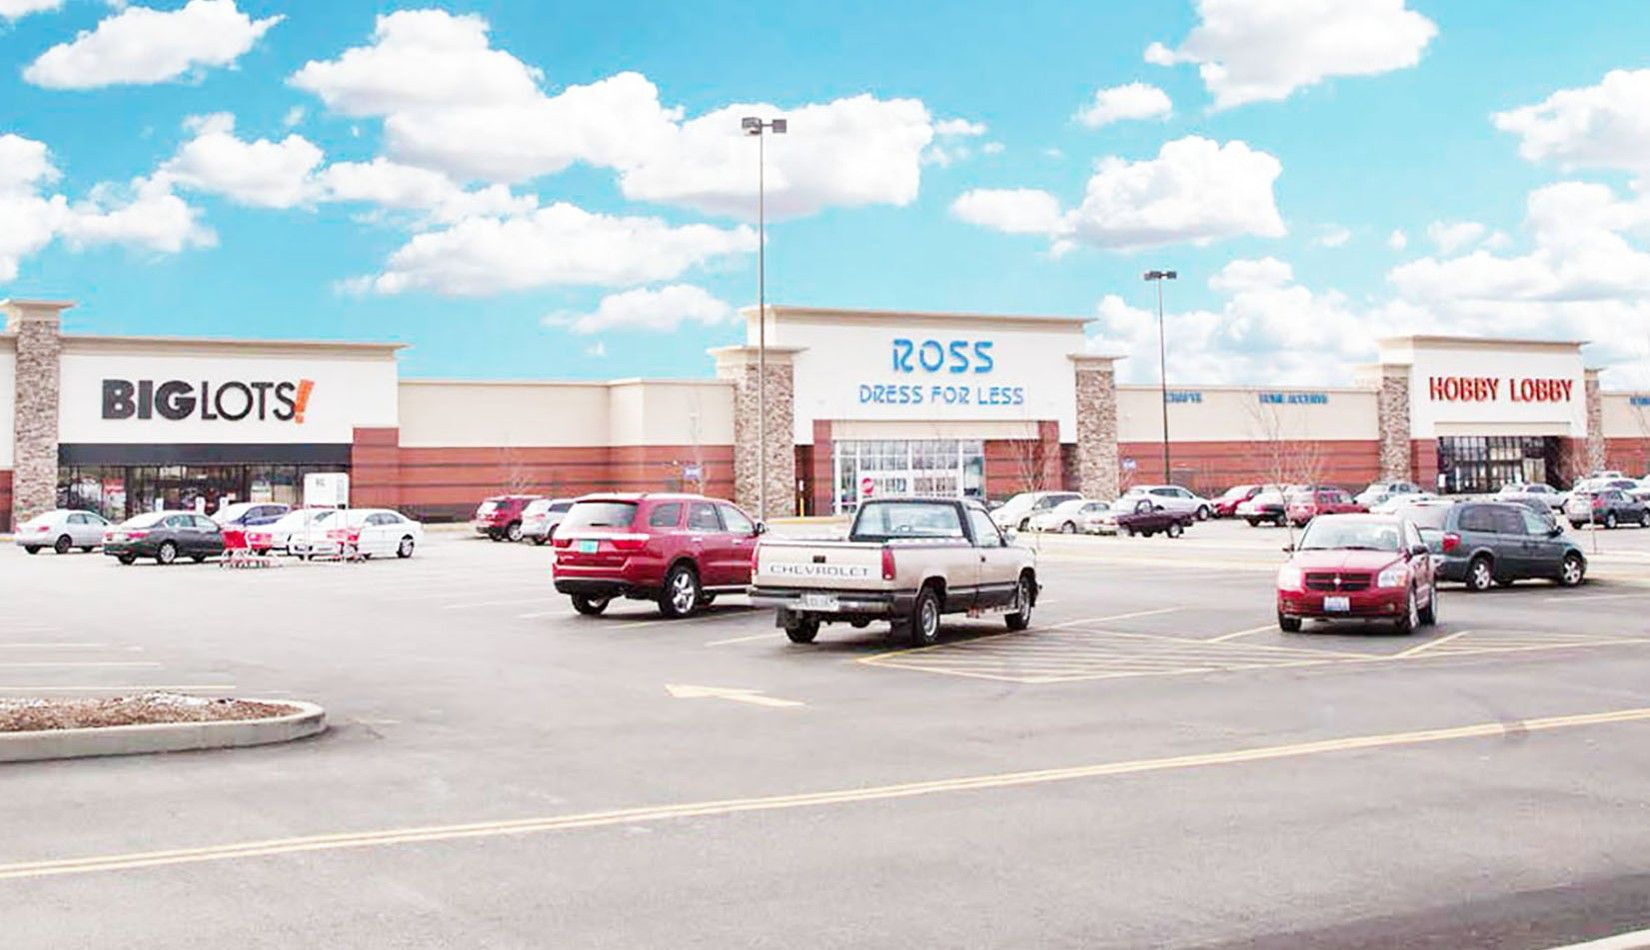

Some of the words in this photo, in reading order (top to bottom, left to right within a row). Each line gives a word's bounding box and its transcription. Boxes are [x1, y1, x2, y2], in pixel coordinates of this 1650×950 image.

[893, 339, 993, 373] ROSS
[859, 384, 923, 404] DRESS
[931, 386, 970, 404] FOR
[978, 387, 1024, 405] LESS
[1429, 376, 1499, 402] HOBBY
[1510, 378, 1573, 402] LOBBY
[770, 564, 868, 577] CHEVROLET
